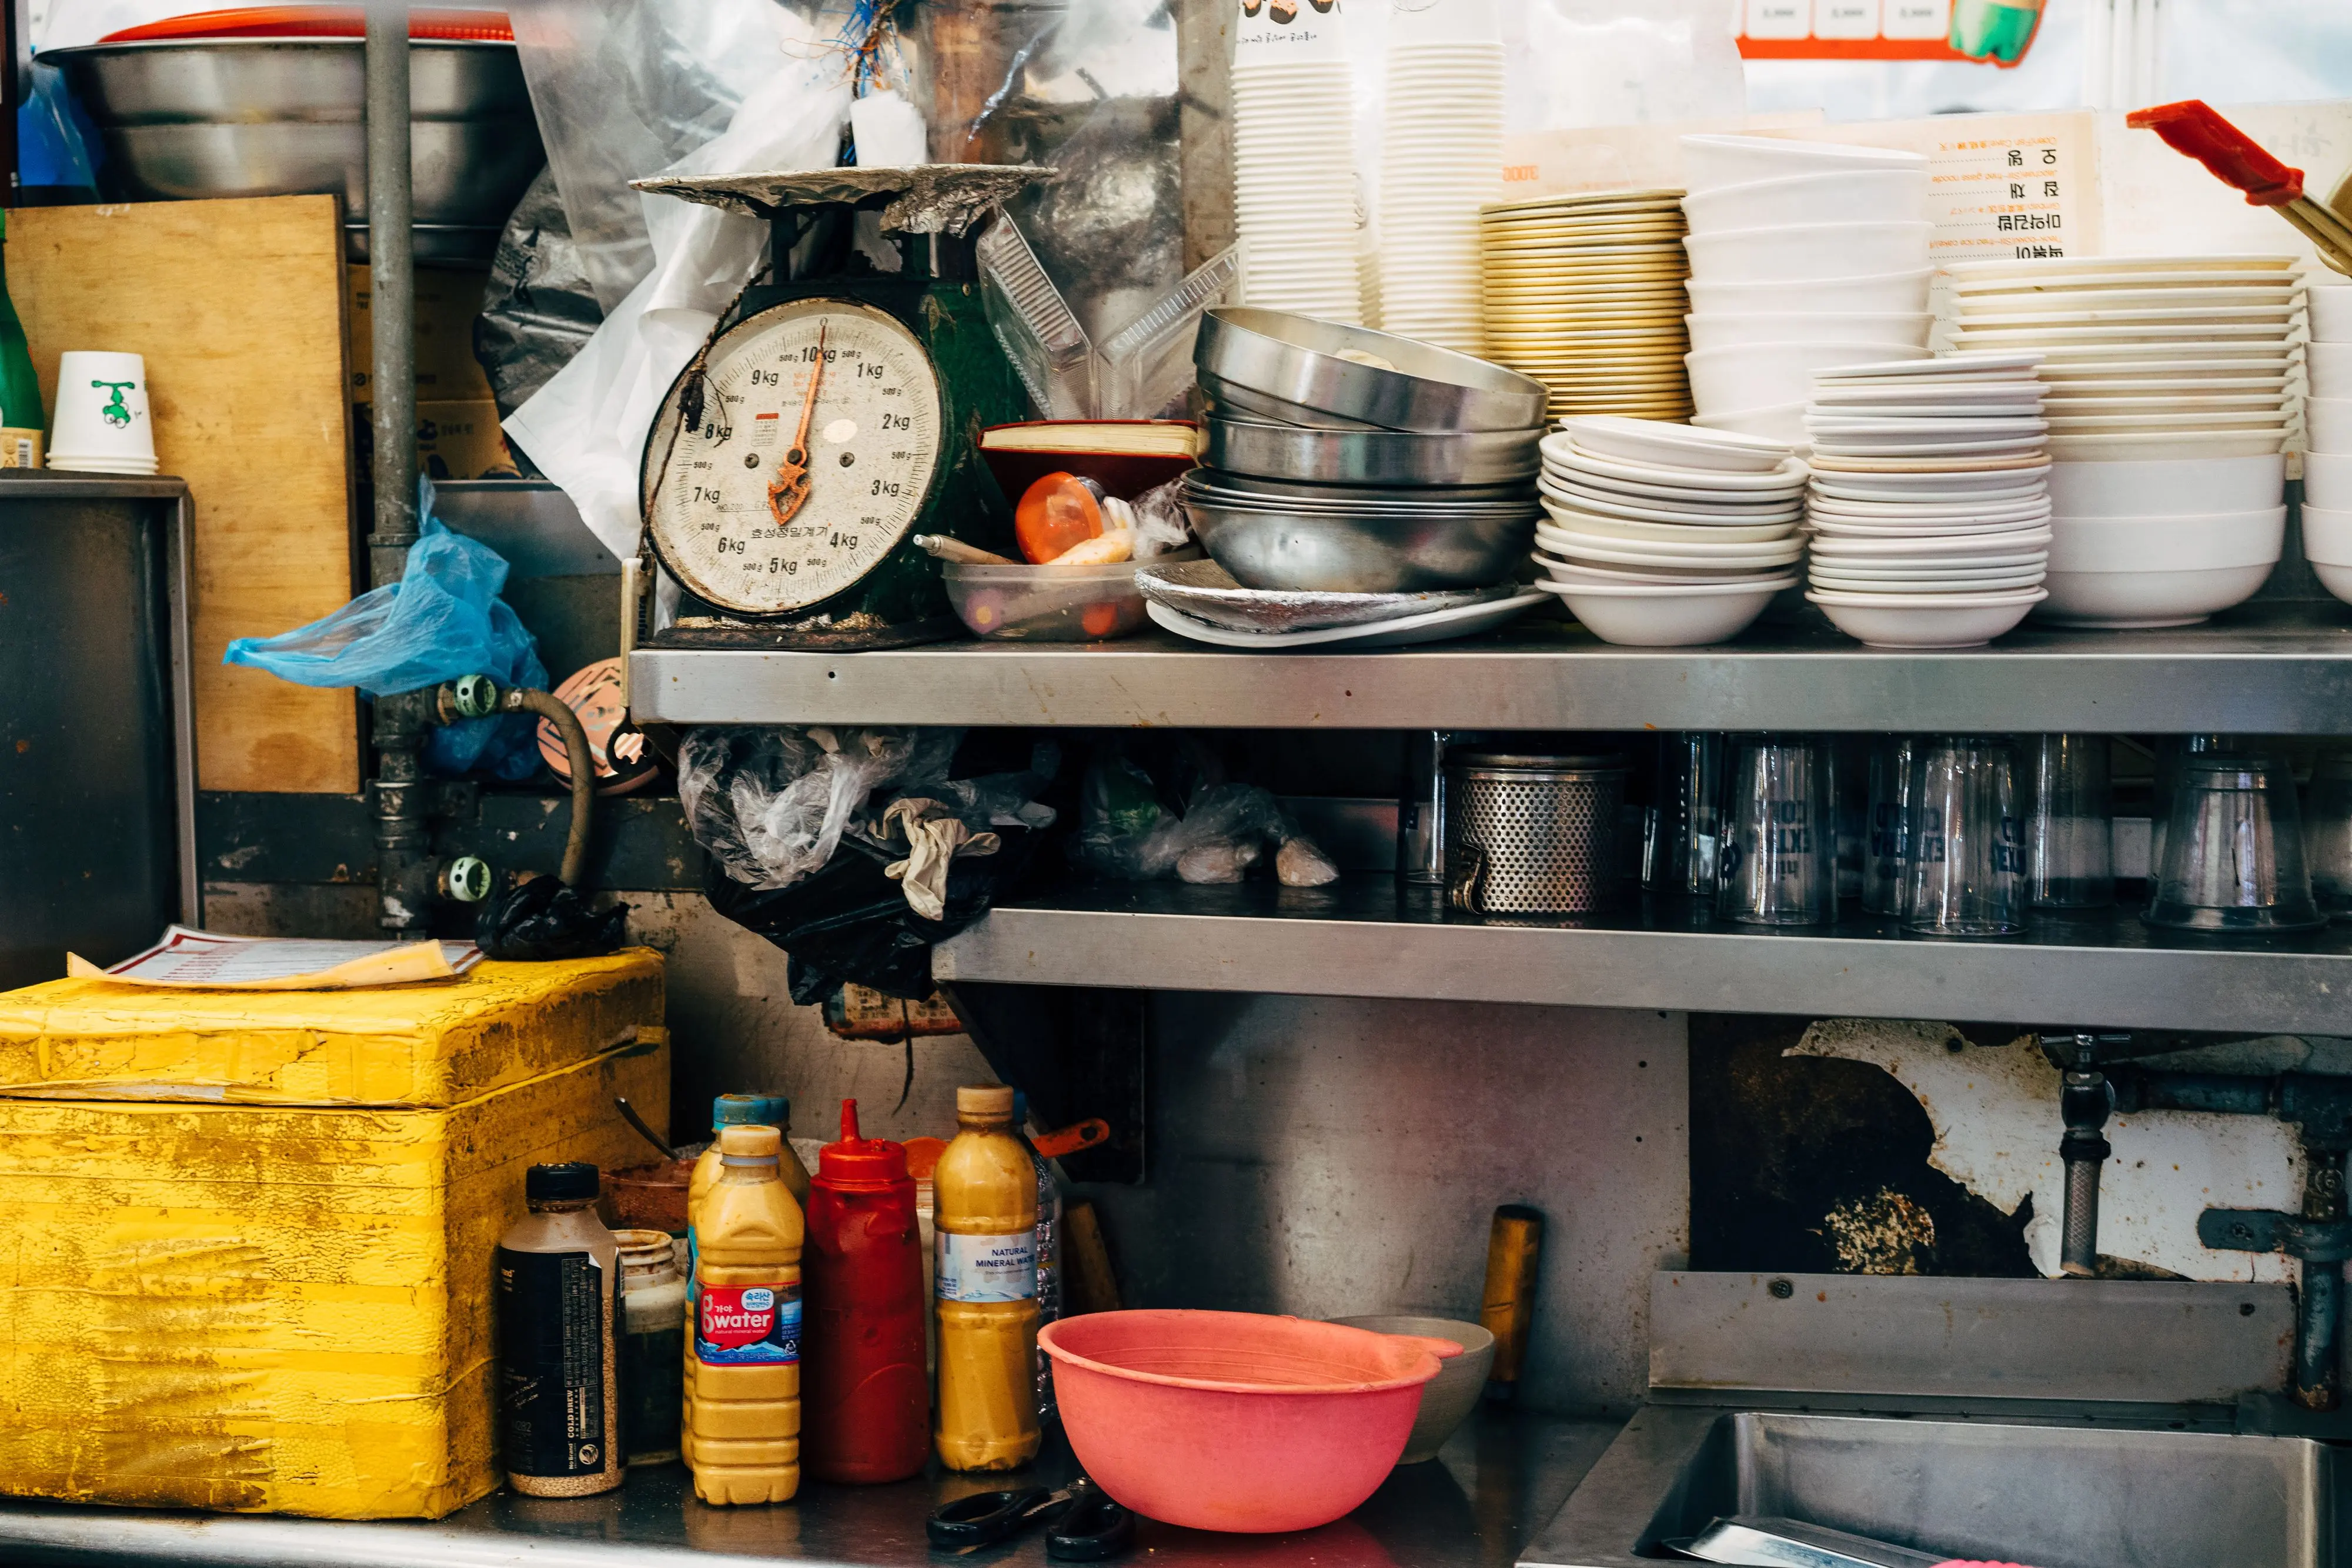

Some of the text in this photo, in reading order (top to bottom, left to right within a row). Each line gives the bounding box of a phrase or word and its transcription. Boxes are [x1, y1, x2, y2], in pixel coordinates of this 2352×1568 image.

[1997, 213, 2061, 231] 마약김밥
[750, 526, 828, 539] 효성정밀계기
[992, 1246, 1028, 1256] NATURAL
[975, 1259, 1015, 1268] MINERAL
[746, 1292, 770, 1301] 속리산
[714, 1305, 733, 1313] 가야
[714, 1312, 771, 1328] water
[569, 1460, 574, 1469] No
